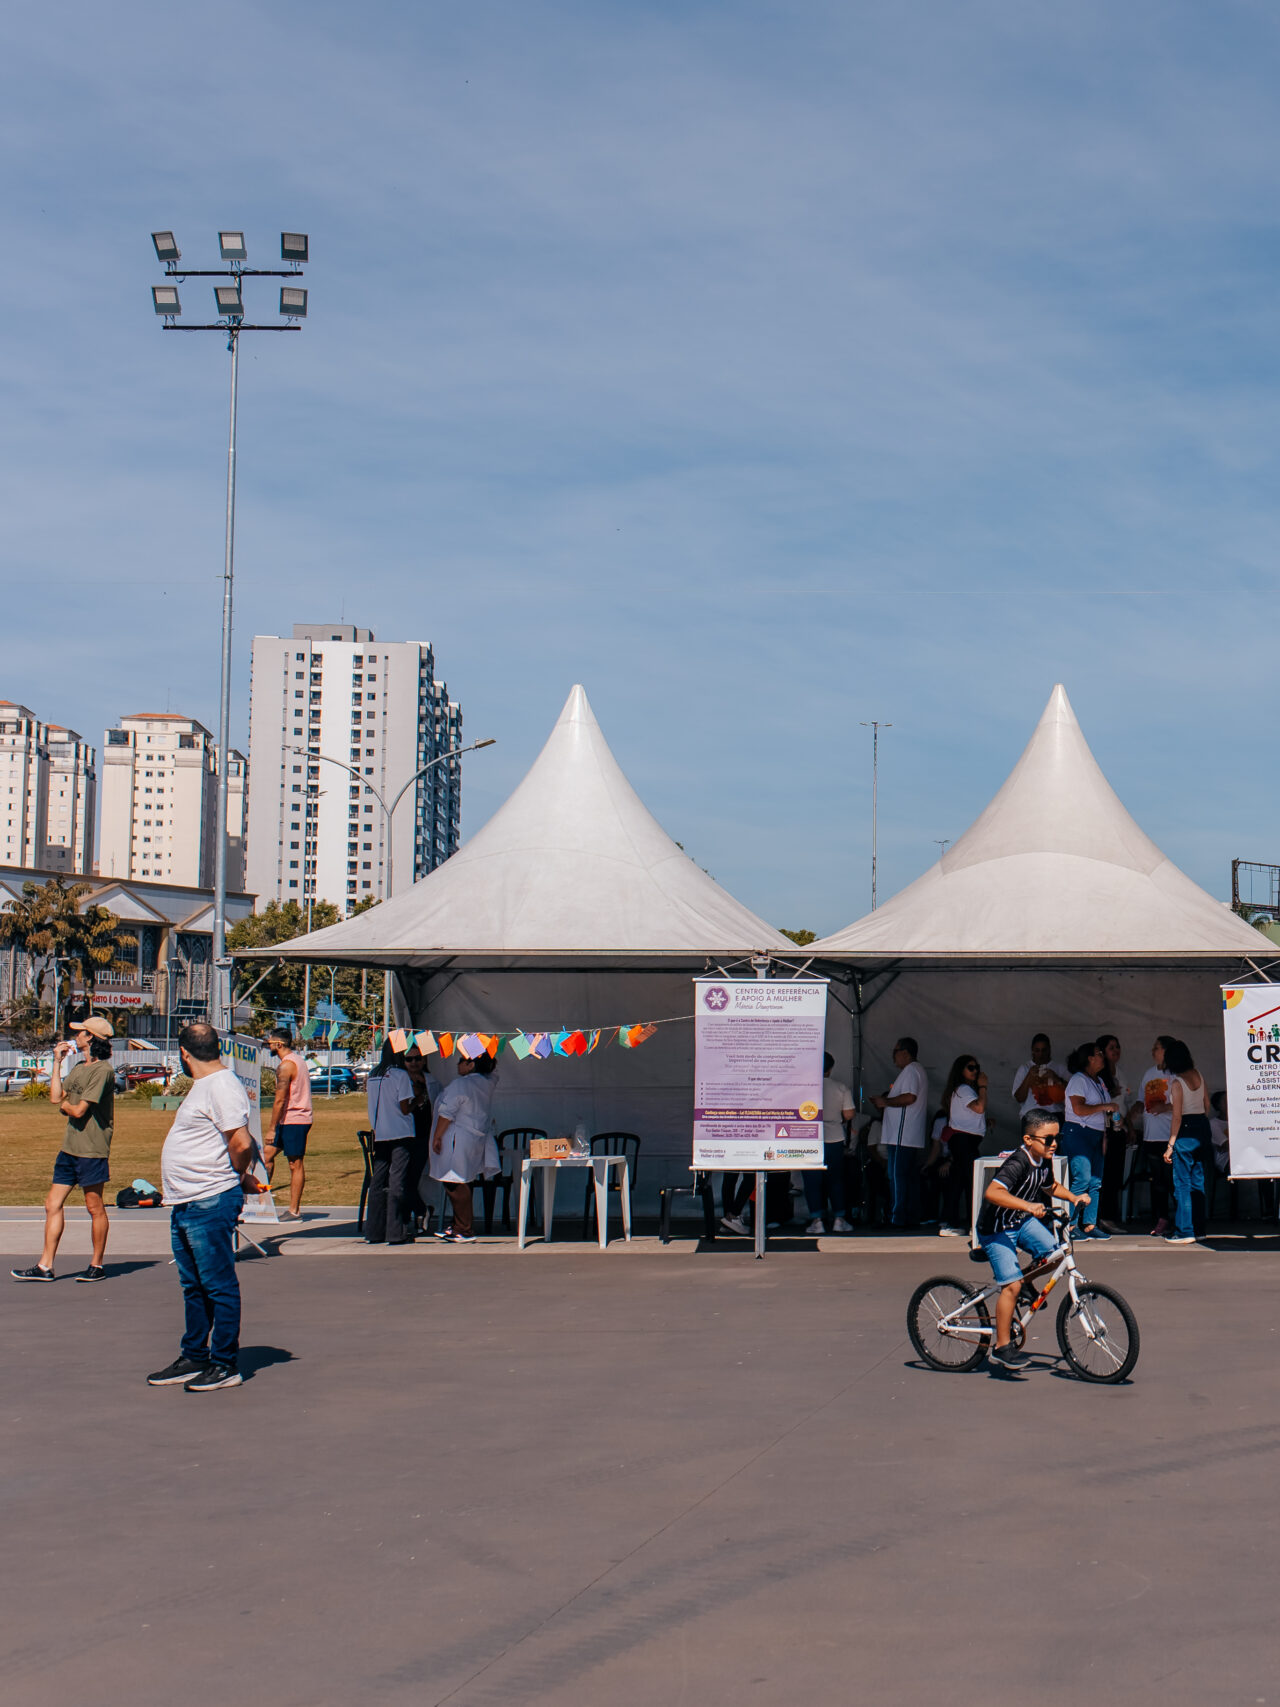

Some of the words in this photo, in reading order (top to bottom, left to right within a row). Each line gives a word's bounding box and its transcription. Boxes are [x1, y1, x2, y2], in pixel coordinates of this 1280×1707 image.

[777, 986, 820, 995] REFERÊNCIA
[218, 1038, 235, 1057] QUI
[236, 1042, 257, 1063] TEM
[22, 1058, 47, 1068] BRT
